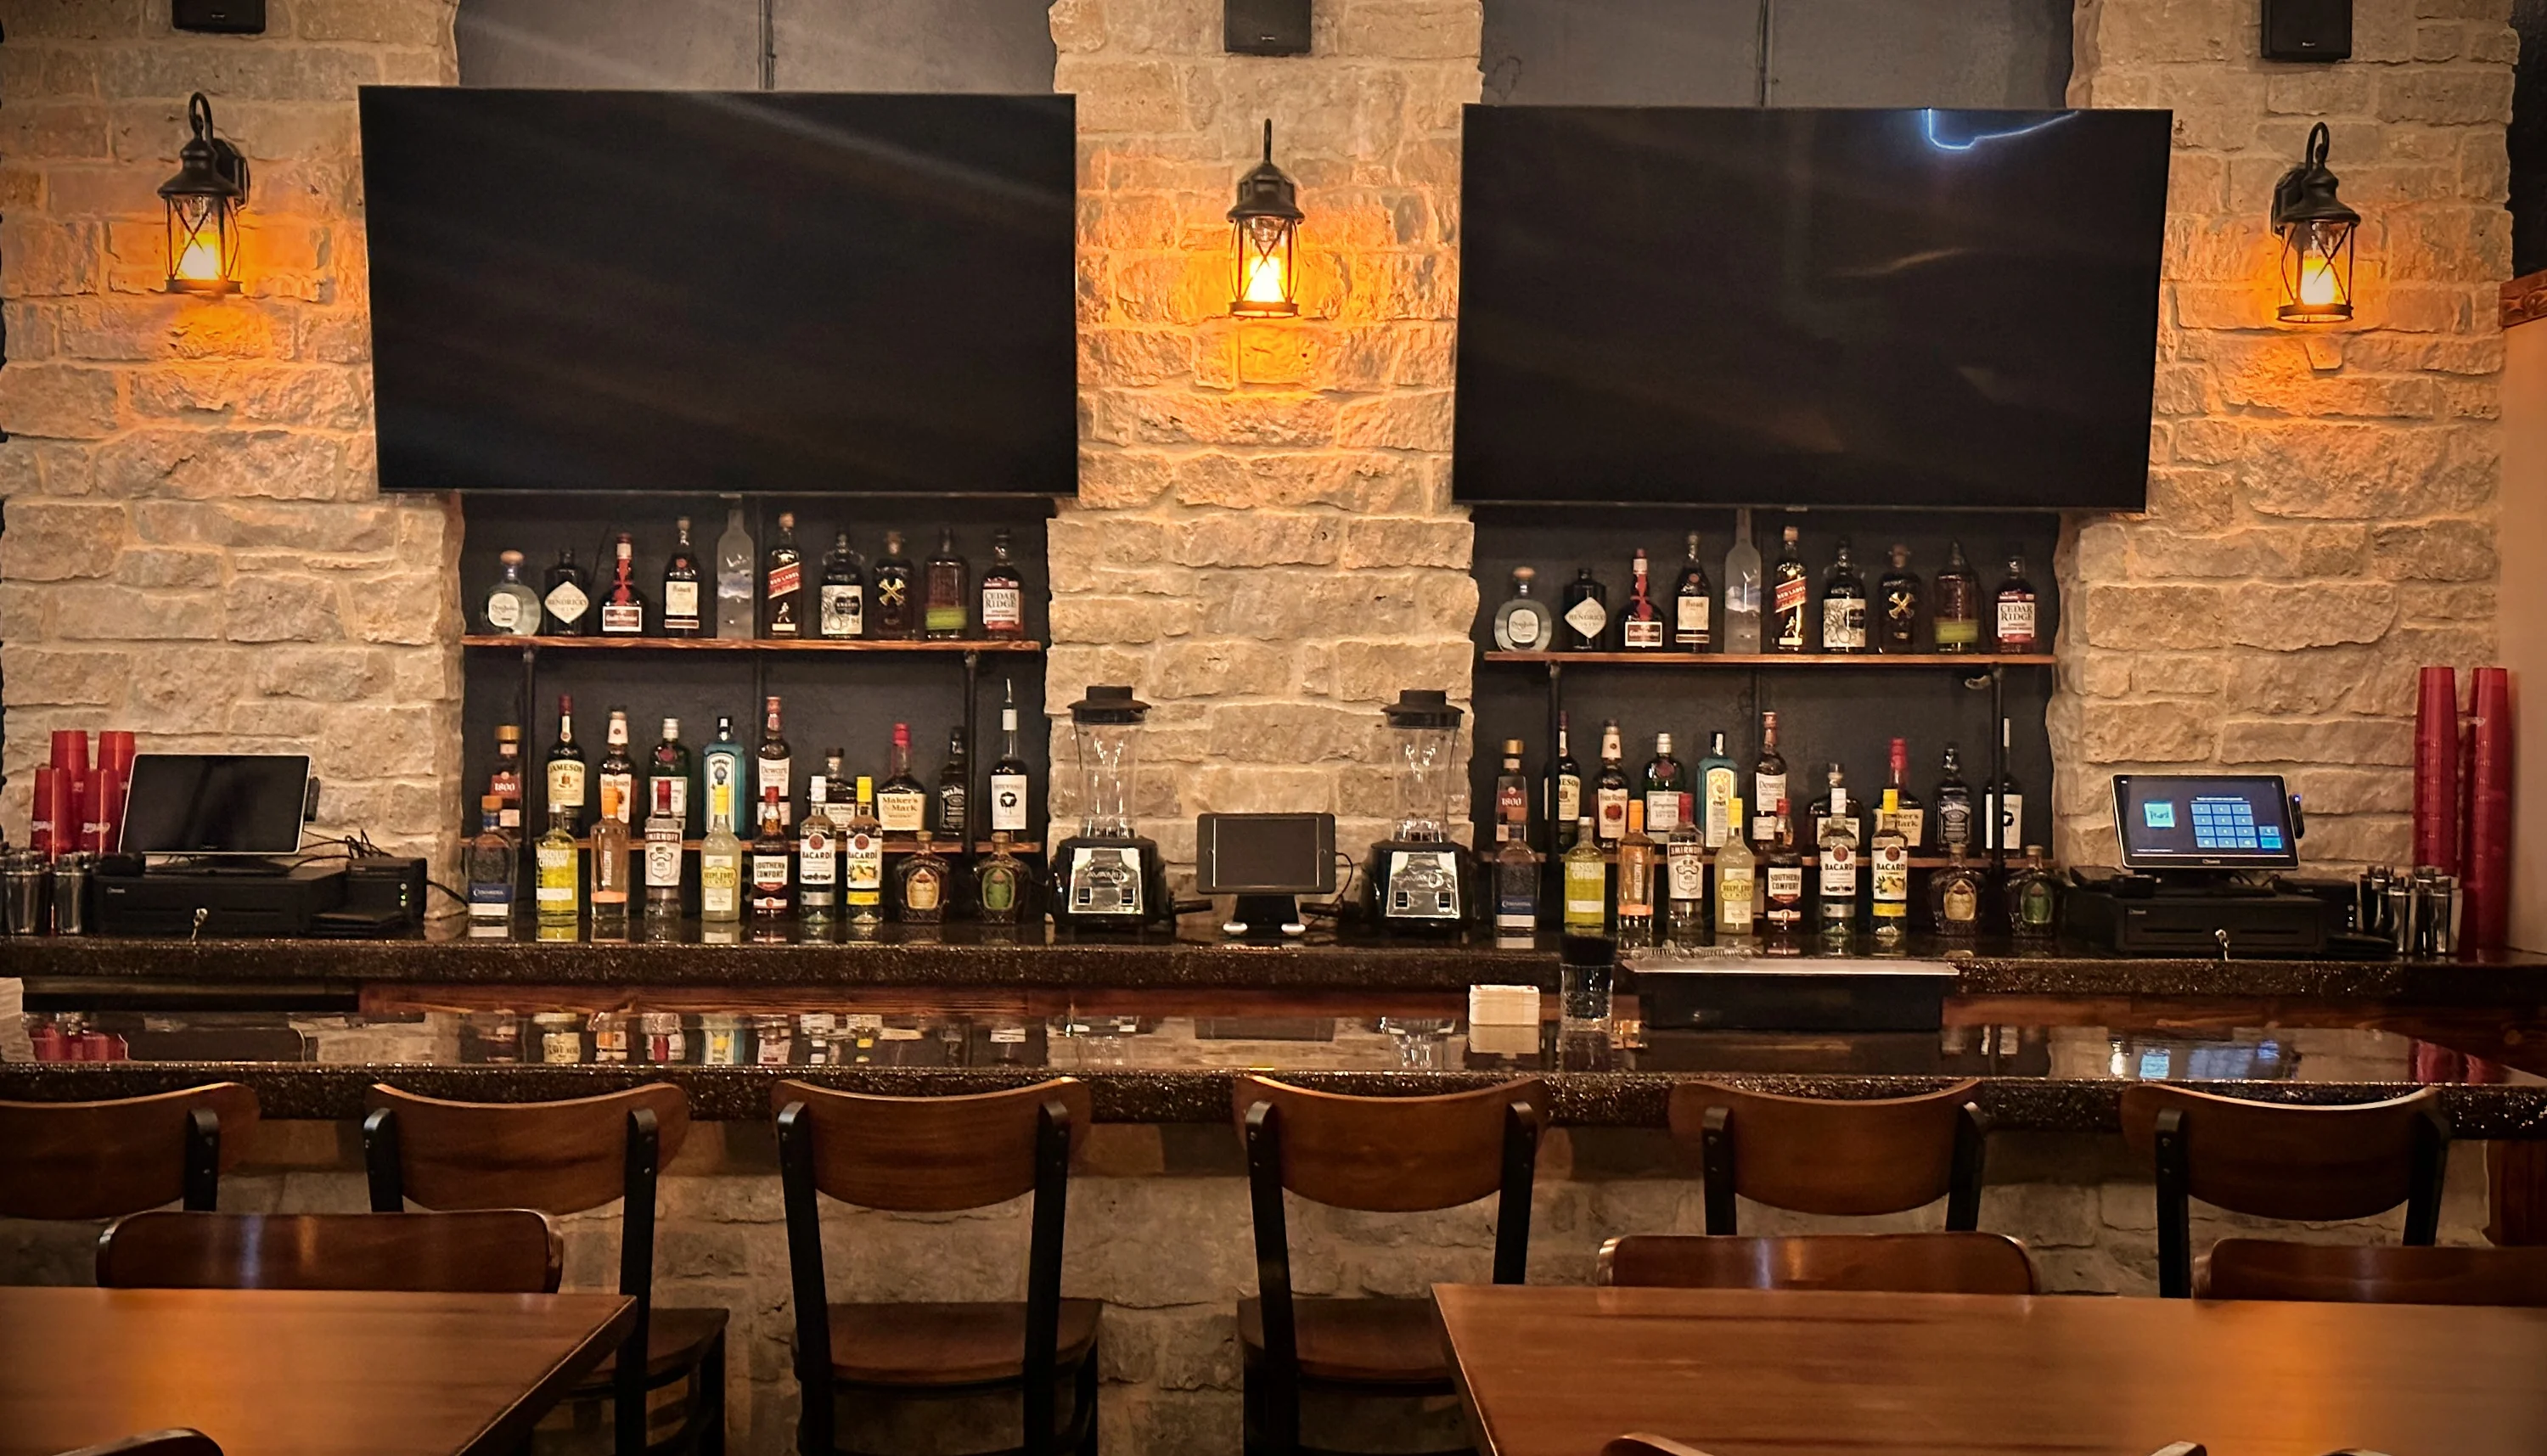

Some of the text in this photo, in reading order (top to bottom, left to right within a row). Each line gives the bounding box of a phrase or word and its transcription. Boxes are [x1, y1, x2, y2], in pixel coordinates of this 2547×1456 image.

[985, 592, 1017, 600] CEDAR
[985, 600, 1017, 609] RIDGE
[2000, 604, 2033, 613] CEDAR
[2001, 612, 2033, 621] RIDGE
[548, 763, 583, 773] JAMESON
[494, 782, 515, 792] 1800
[883, 796, 919, 805] Maker's
[1501, 797, 1522, 807] 1800
[1669, 846, 1704, 857] SMIRNOFF
[1770, 874, 1800, 882] SOUTHERN
[1772, 881, 1799, 890] COMFORT
